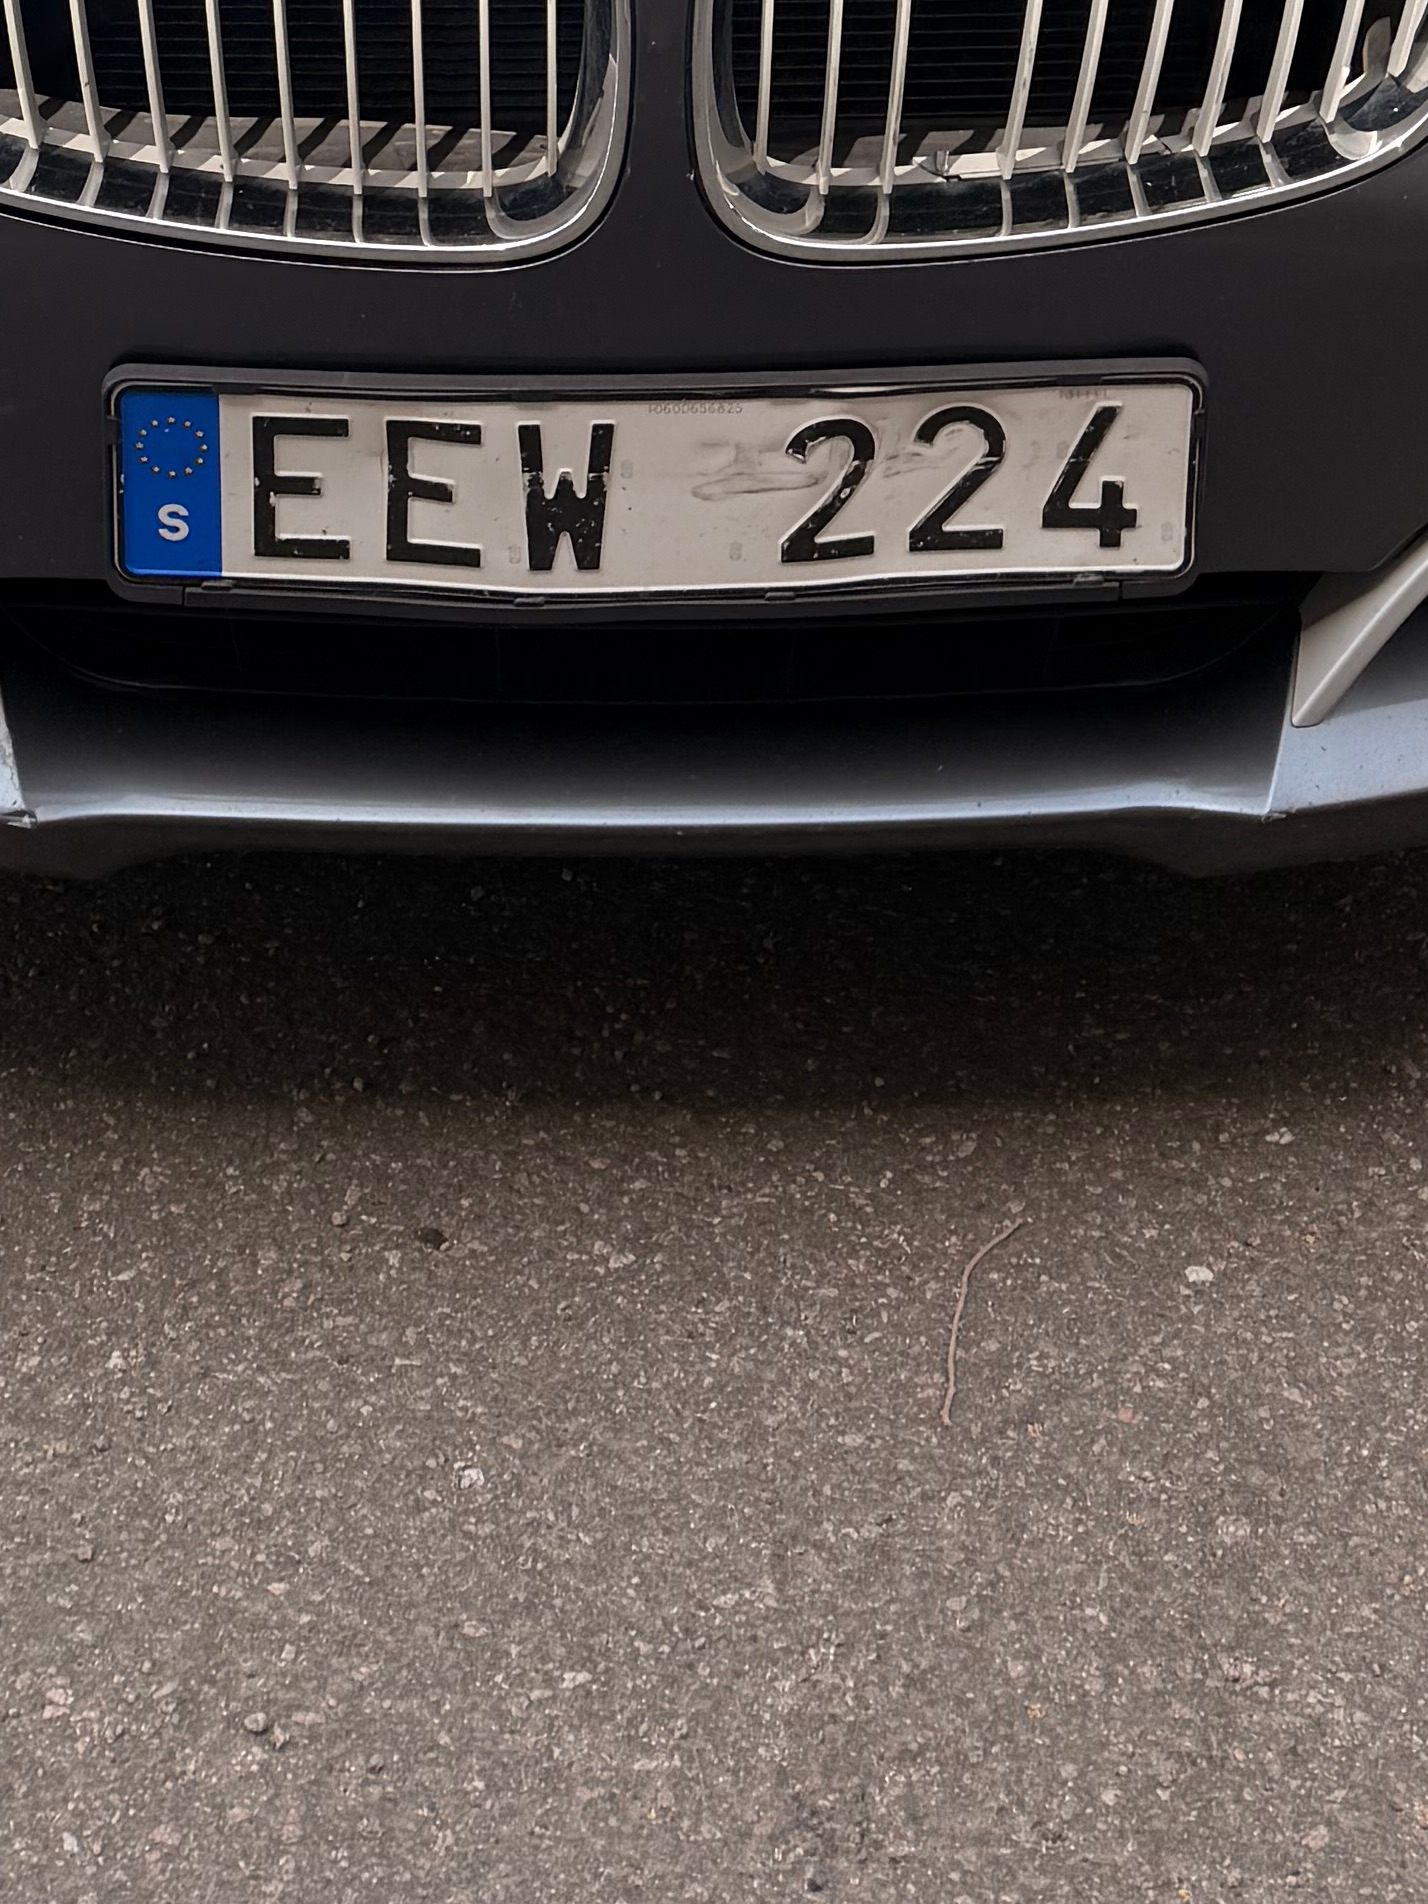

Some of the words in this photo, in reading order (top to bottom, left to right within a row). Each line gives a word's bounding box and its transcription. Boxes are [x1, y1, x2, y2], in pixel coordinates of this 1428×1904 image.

[157, 503, 190, 541] S
[251, 414, 615, 572] EEW
[779, 405, 1139, 565] 224
